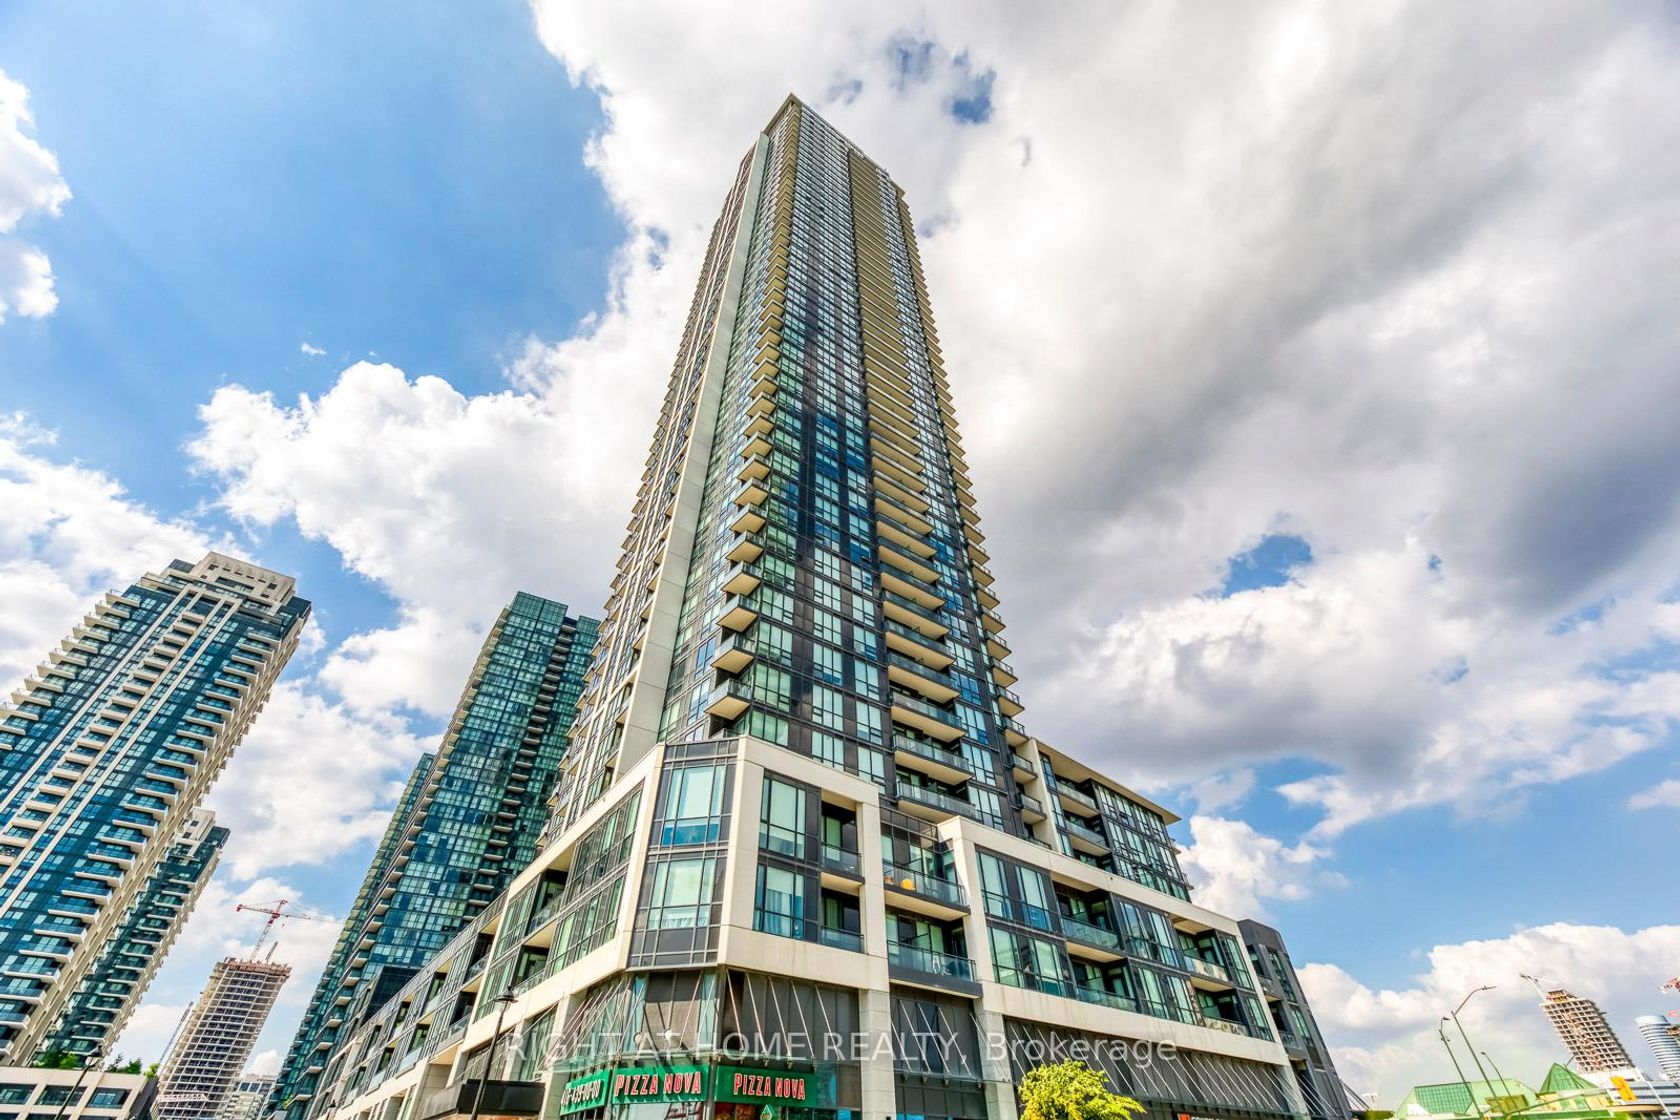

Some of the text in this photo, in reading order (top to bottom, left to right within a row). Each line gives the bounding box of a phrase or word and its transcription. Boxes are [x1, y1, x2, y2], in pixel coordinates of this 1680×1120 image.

[614, 1071, 701, 1096] PIZZA NOVA
[733, 1072, 806, 1100] PIZZA NOVA
